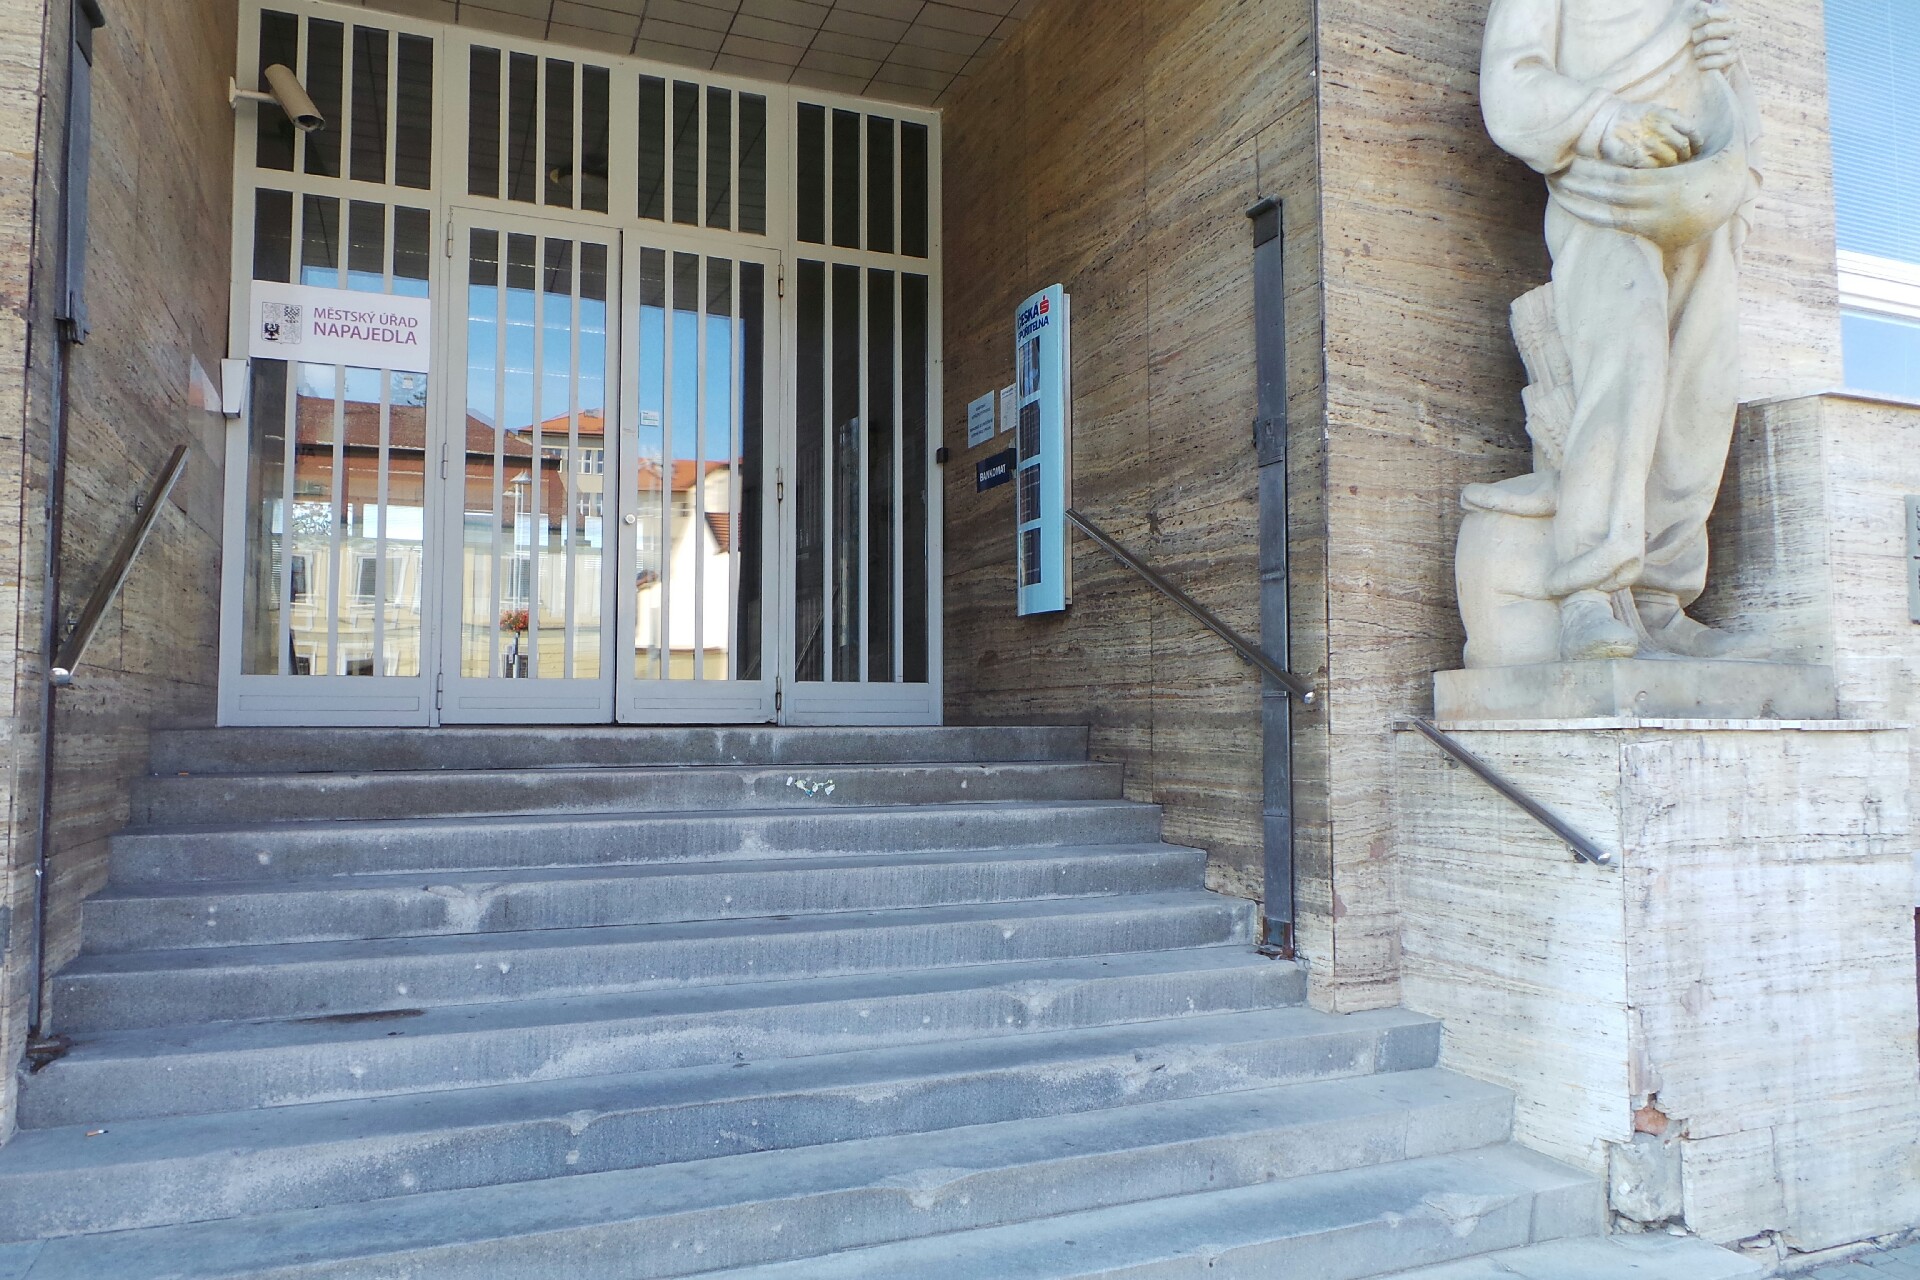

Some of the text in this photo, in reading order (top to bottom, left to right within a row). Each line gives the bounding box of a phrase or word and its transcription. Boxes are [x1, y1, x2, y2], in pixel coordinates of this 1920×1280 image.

[313, 306, 418, 328] MĚSTSKÝ ÚŘAD
[313, 321, 418, 346] NAPAJEDLA
[979, 463, 1006, 482] BANKOMAT
